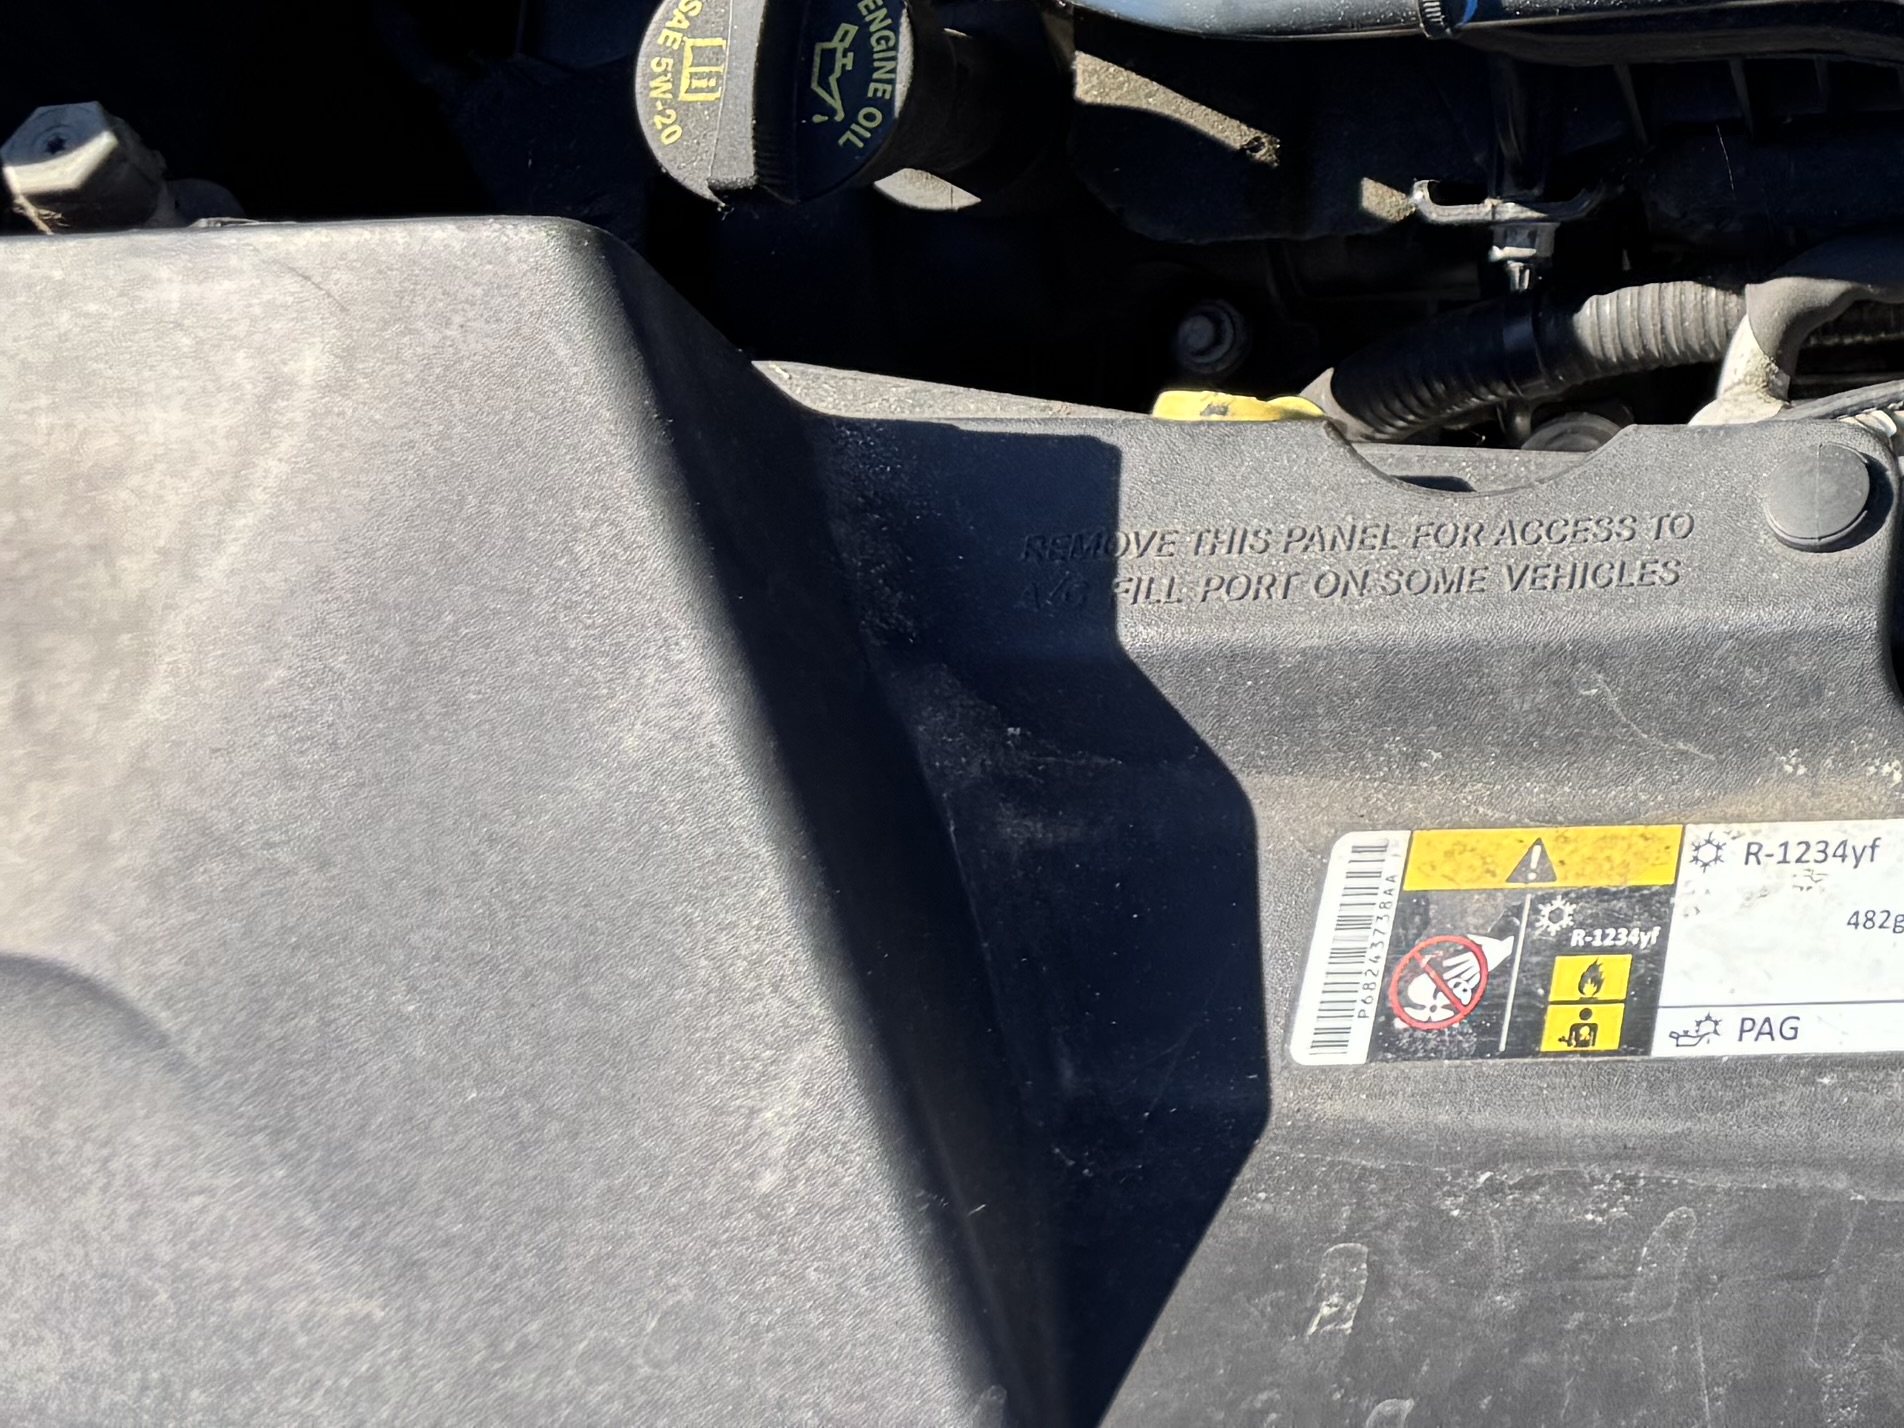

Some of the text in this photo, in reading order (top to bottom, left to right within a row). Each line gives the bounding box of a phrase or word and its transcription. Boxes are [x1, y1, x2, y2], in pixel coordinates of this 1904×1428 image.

[649, 56, 683, 145] 5W-20
[838, 106, 883, 149] OIL
[1020, 511, 1696, 561] REMOVE THIS PANEL FOR ACCESS TO
[1111, 575, 1183, 606] FILL
[1199, 571, 1300, 605] PORT
[1313, 568, 1370, 599] ON
[1381, 565, 1489, 597] SOME
[1503, 559, 1684, 594] VEHICLES
[1743, 838, 1883, 868] R-1234yf
[1357, 874, 1398, 1019] P68243738AA
[1570, 926, 1660, 949] R-1234yf
[1737, 1016, 1801, 1043] PAG
